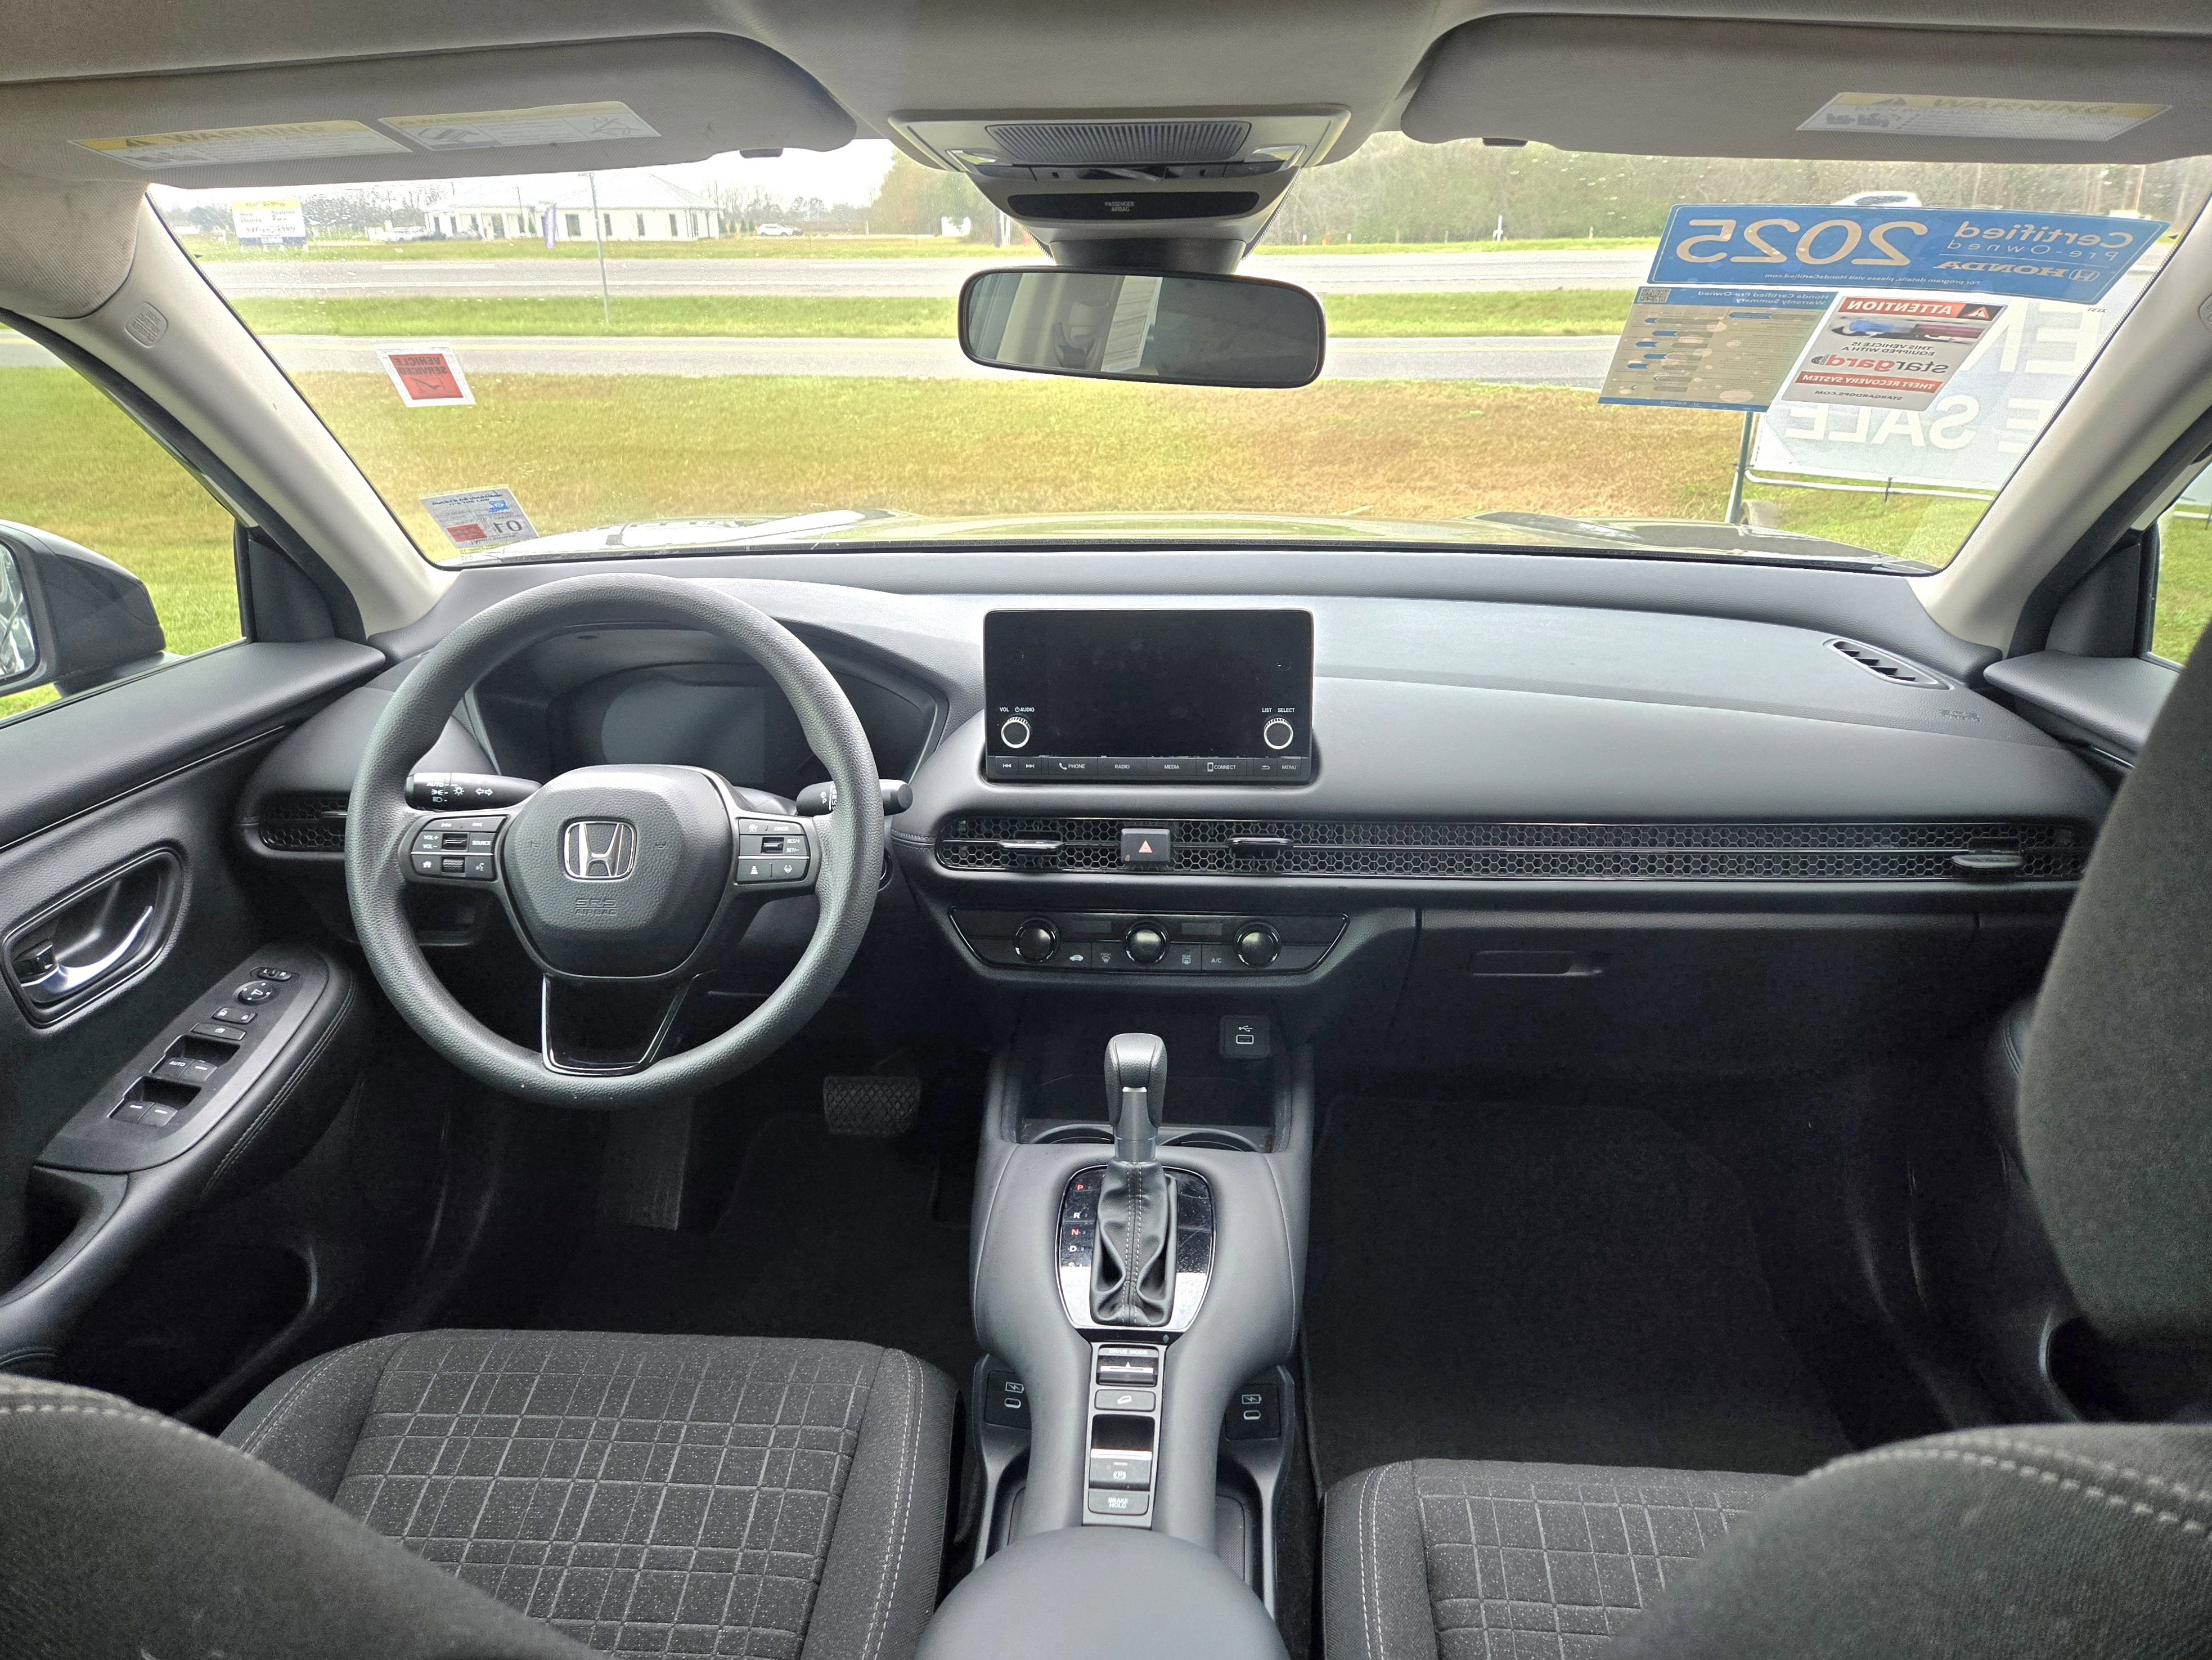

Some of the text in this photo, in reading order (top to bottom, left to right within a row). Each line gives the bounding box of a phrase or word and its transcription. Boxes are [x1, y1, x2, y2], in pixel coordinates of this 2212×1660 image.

[1933, 97, 2114, 115] WARNING
[164, 124, 327, 143] WARNING
[131, 320, 156, 343] AIRBAG
